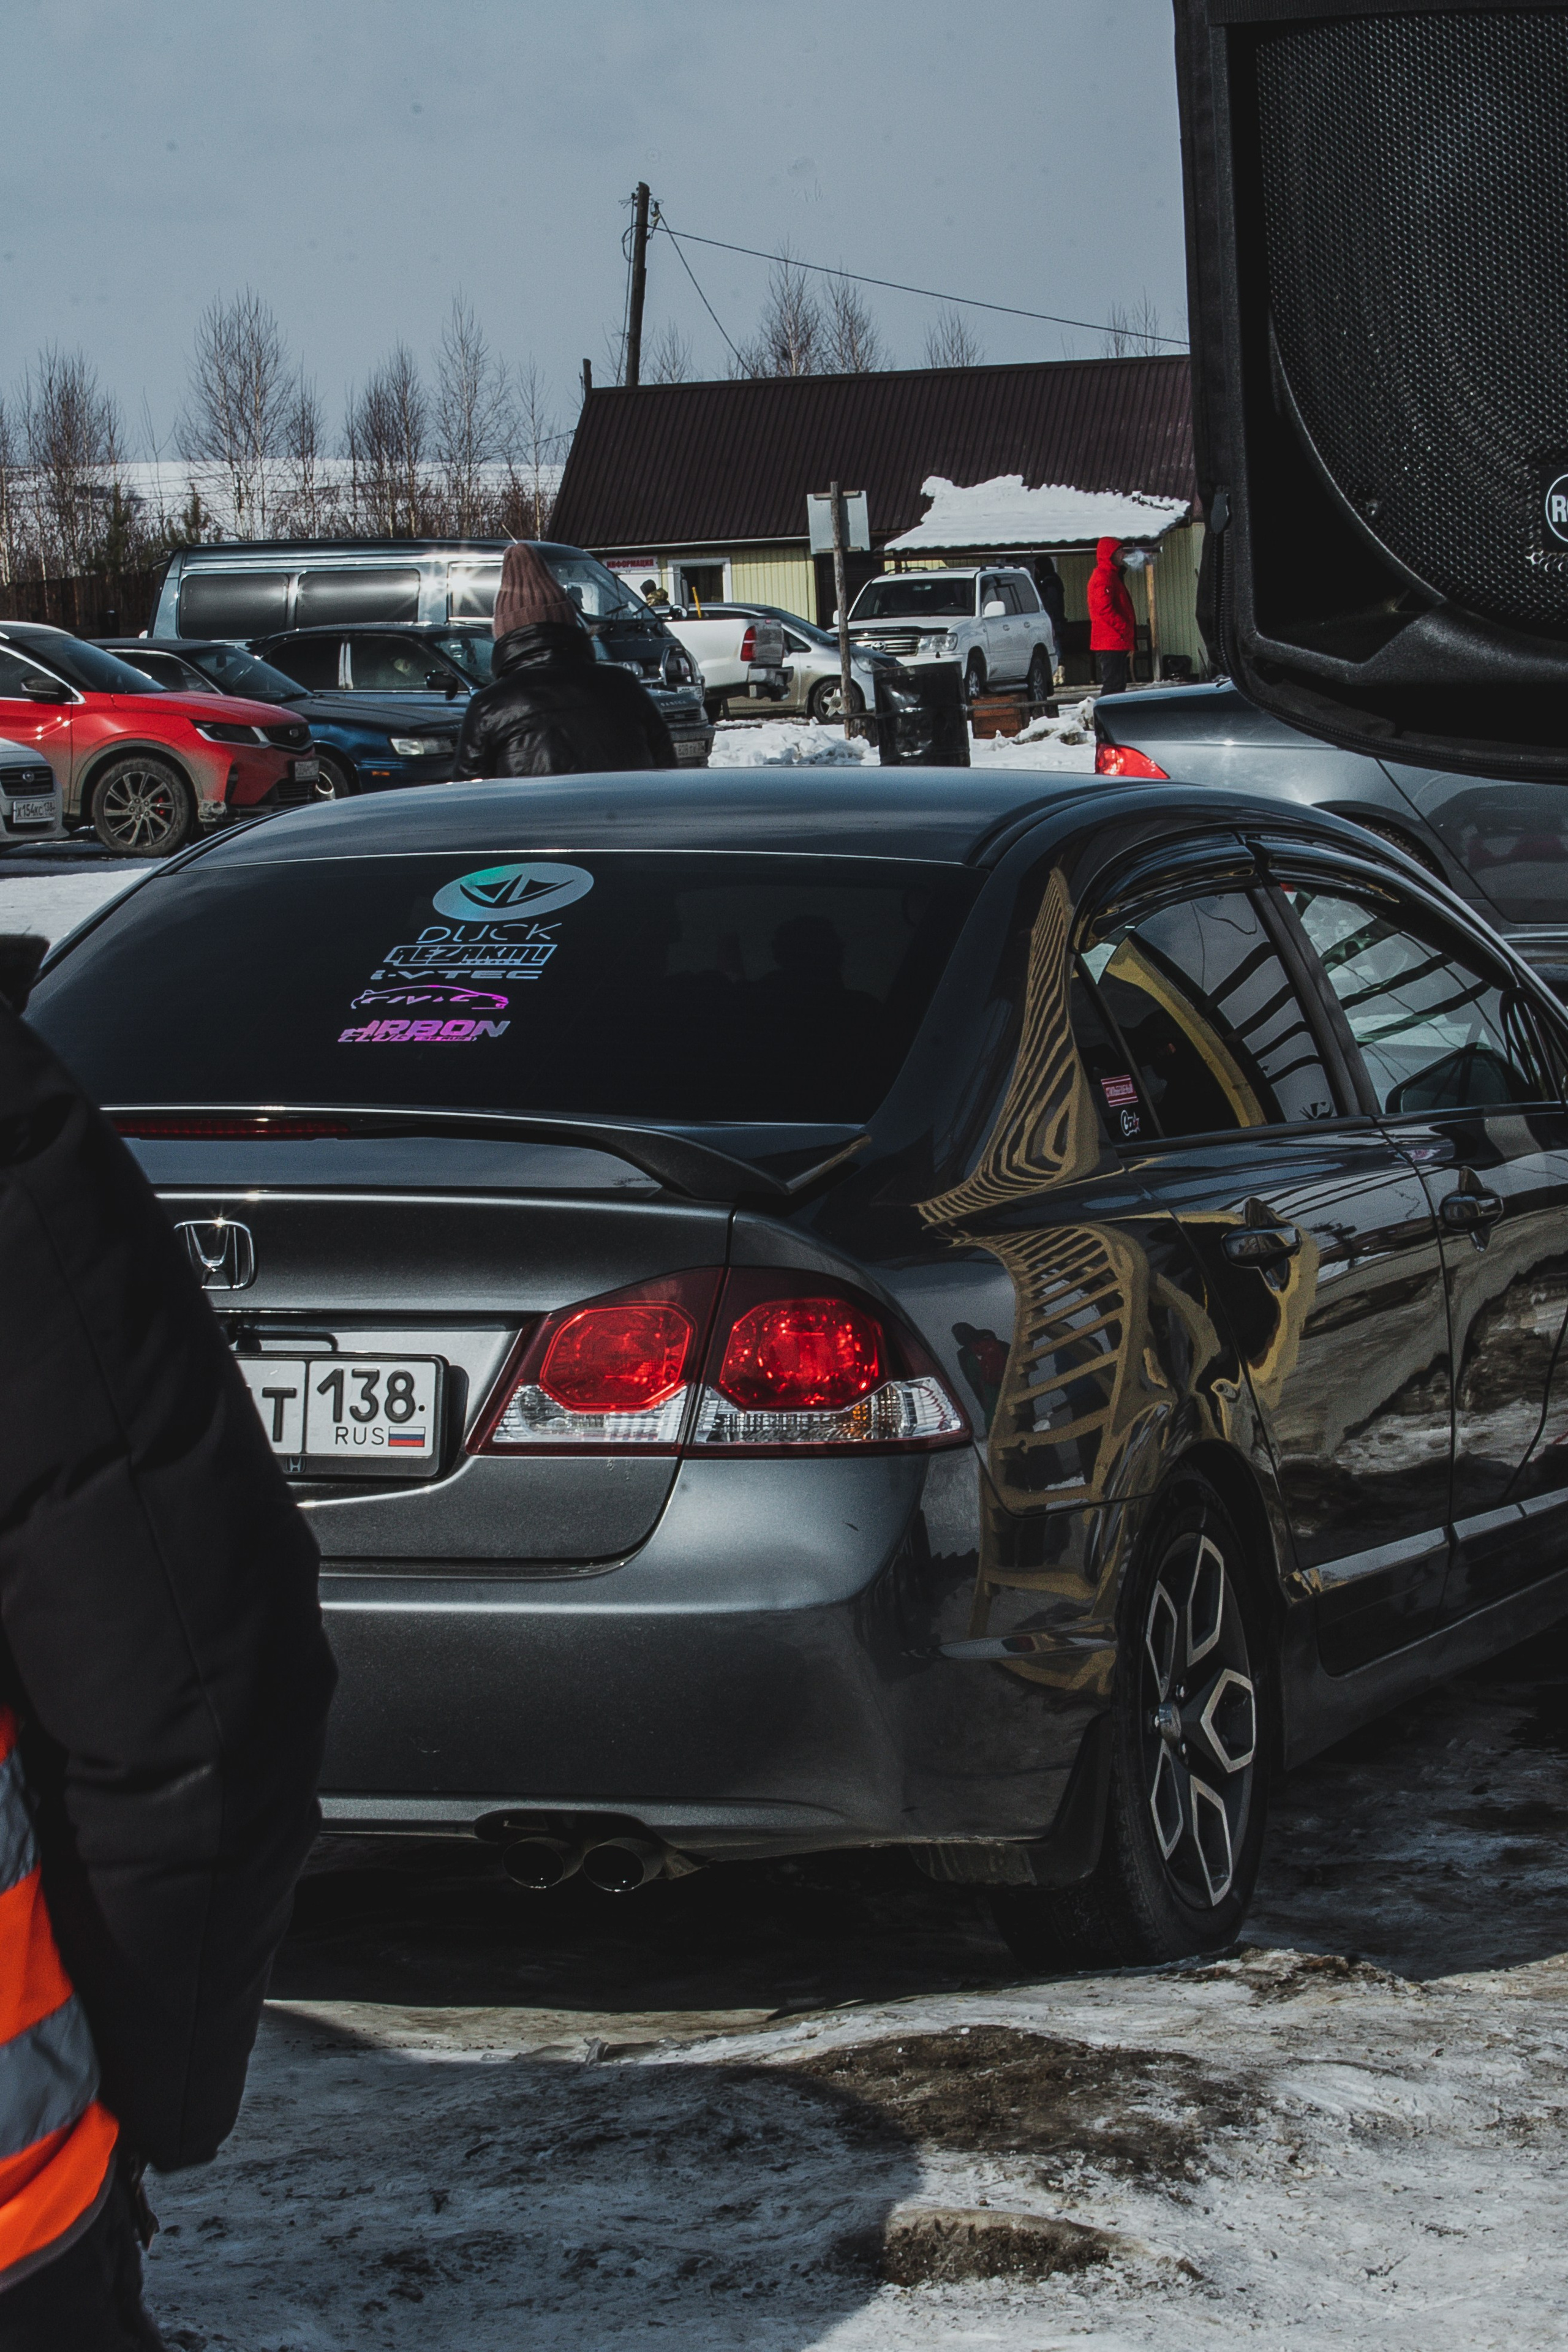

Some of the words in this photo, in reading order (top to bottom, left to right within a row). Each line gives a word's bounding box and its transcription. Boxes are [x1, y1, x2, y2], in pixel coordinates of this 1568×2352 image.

[606, 559, 654, 568] ИНФОРМАЦИЯ
[415, 923, 562, 944] DUCK
[317, 1368, 417, 1423] 138
[334, 1426, 385, 1446] RUS
